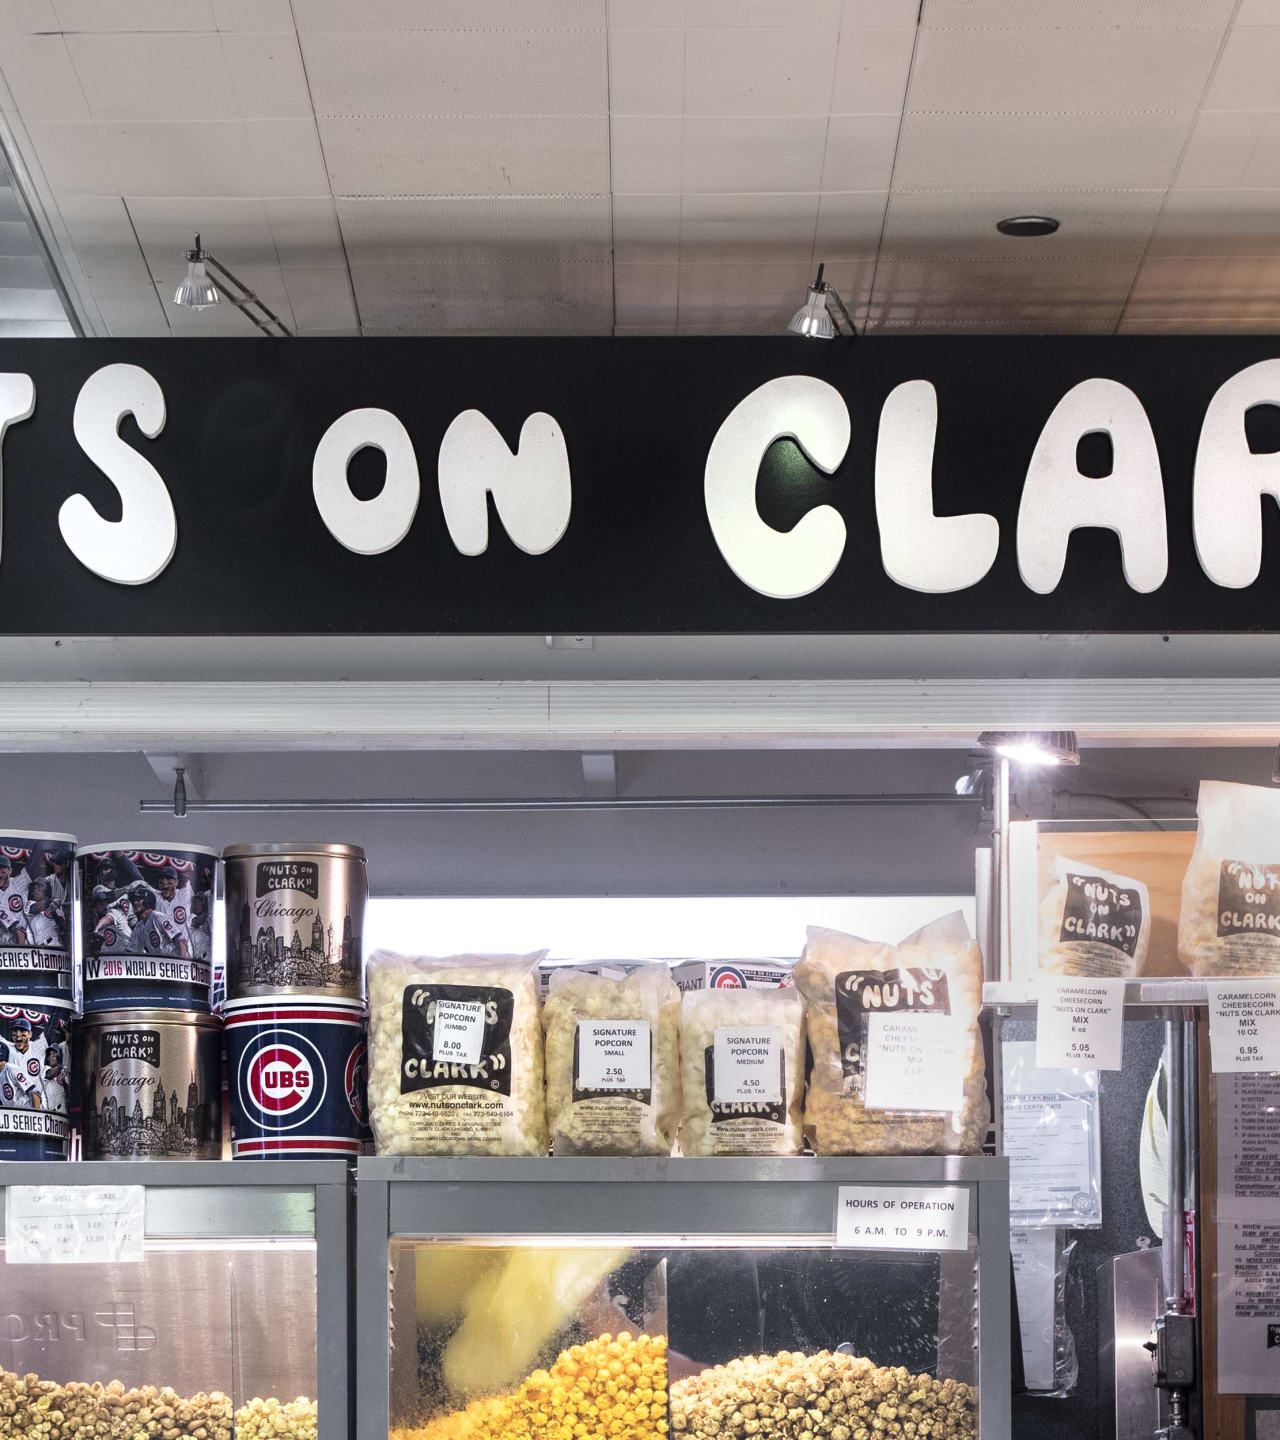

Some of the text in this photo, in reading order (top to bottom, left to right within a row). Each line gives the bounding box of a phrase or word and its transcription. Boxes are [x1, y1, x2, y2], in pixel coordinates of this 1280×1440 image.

[312, 407, 573, 557] ON
[263, 865, 297, 875] "NUTS
[268, 878, 312, 889] CLARK"
[254, 900, 315, 923] Chicago
[845, 975, 934, 1008] "NUTS
[438, 1001, 481, 1012] SIGNATURE
[439, 1012, 475, 1022] POPCORN
[106, 1034, 140, 1045] "NUTS
[443, 1041, 461, 1049] 8.00
[111, 1046, 154, 1058] CLARK"
[1240, 1046, 1258, 1054] 6.95
[99, 1069, 156, 1093] Chicago
[249, 1047, 310, 1112] CUBS
[409, 1101, 503, 1109] www.nutsonclark.com
[13, 1116, 42, 1132] SERIES
[846, 1200, 878, 1208] HOURS
[901, 1202, 954, 1210] OPERATION
[865, 1227, 886, 1235] A.M.
[928, 1229, 948, 1237] P.M.
